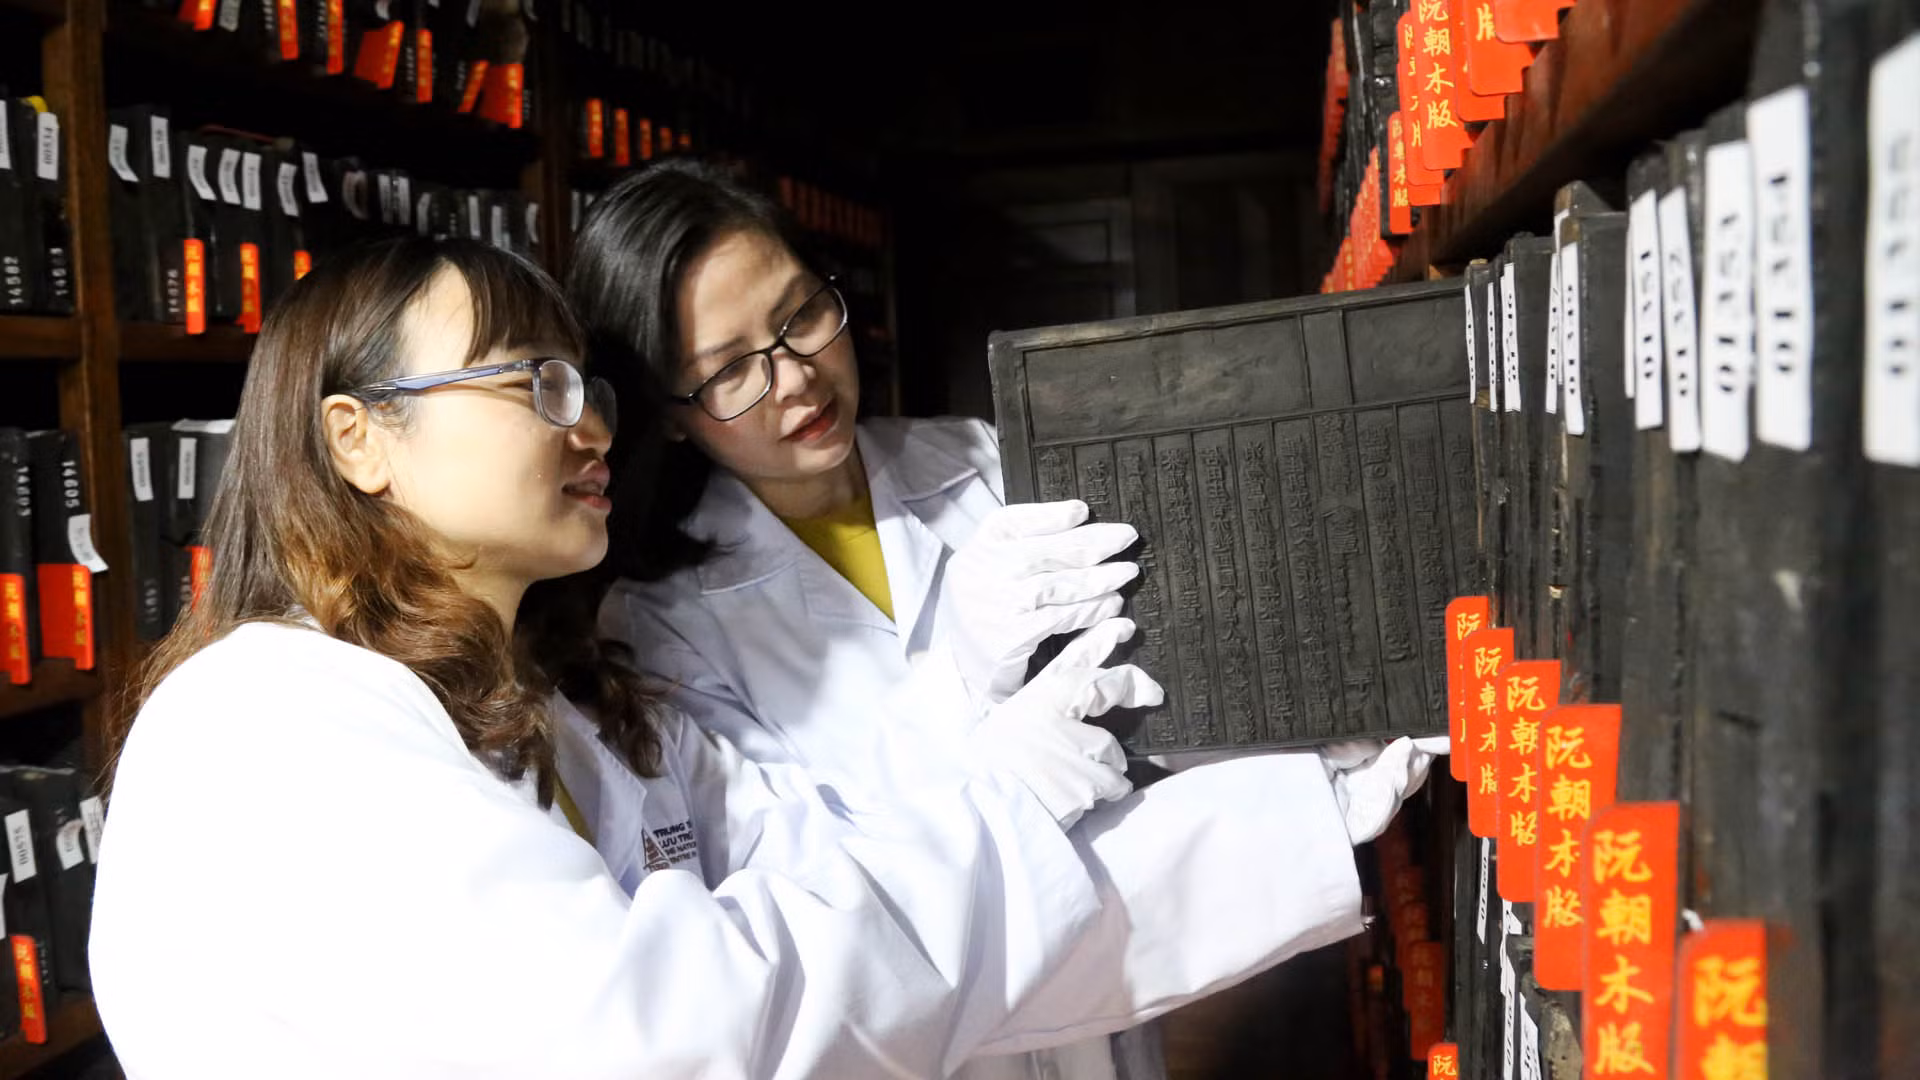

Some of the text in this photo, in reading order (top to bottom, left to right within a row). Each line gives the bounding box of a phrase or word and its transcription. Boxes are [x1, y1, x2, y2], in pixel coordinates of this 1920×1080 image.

[1418, 0, 1459, 129] 阮朝木版
[1544, 726, 1593, 929] 阮朝木版
[1593, 829, 1656, 1076] 阮朝木版
